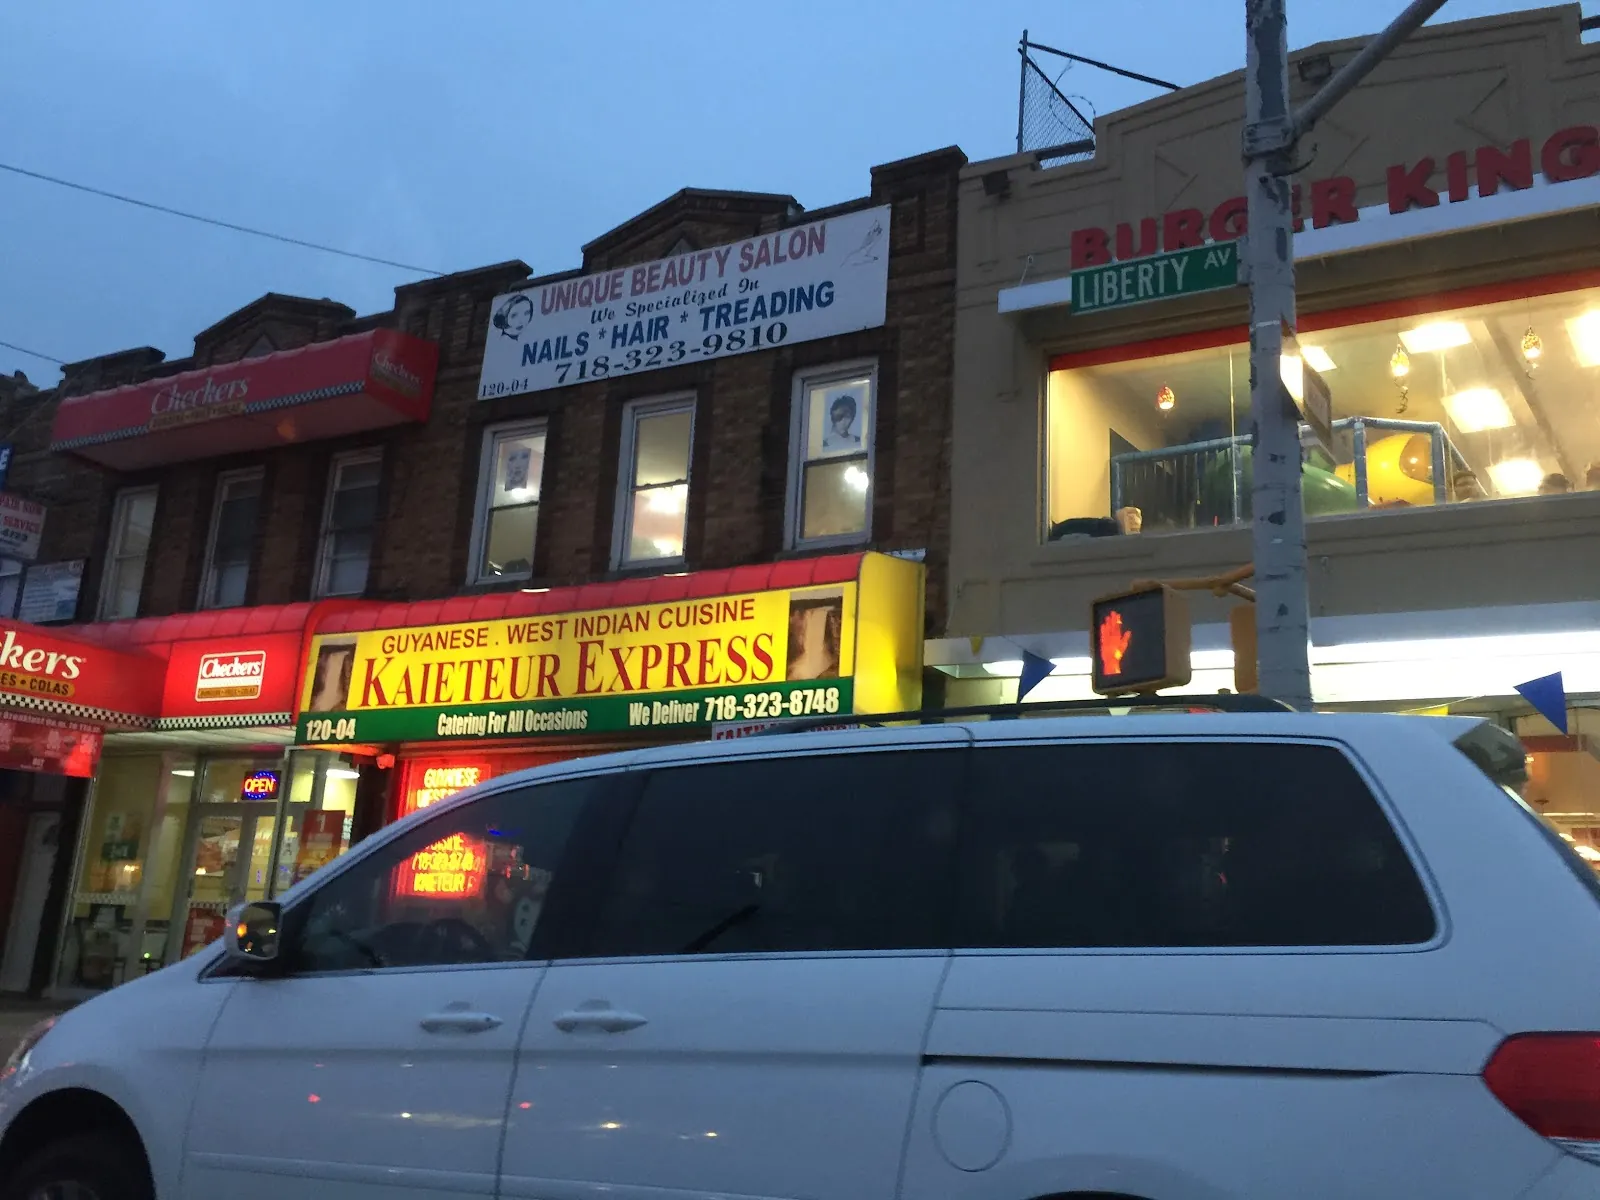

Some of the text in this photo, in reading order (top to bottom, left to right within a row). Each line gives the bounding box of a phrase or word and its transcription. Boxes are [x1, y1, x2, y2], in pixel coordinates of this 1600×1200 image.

[1071, 125, 1600, 270] BURGR KING
[540, 223, 826, 316] UNIQUE BEAUTY SALON
[1079, 247, 1231, 309] LIBERTY AV
[521, 280, 835, 367] NAILS HAIR TREADING
[590, 307, 616, 325] We
[625, 283, 728, 319] Specialized
[555, 321, 788, 384] 718-323-9810
[481, 377, 529, 398] 120-04
[381, 598, 756, 654] GUYANESE WEST INDIAN CUISINE
[0, 631, 80, 680] kers
[202, 656, 262, 678] Checkers
[359, 632, 774, 708] KAIETEUR EXPRESS
[29, 678, 69, 696] COLAS
[629, 687, 840, 726] We Deliver 718-323-8748
[306, 718, 356, 741] 120-04
[437, 707, 588, 737] Catering For All Occasions
[244, 778, 275, 792] OPEN
